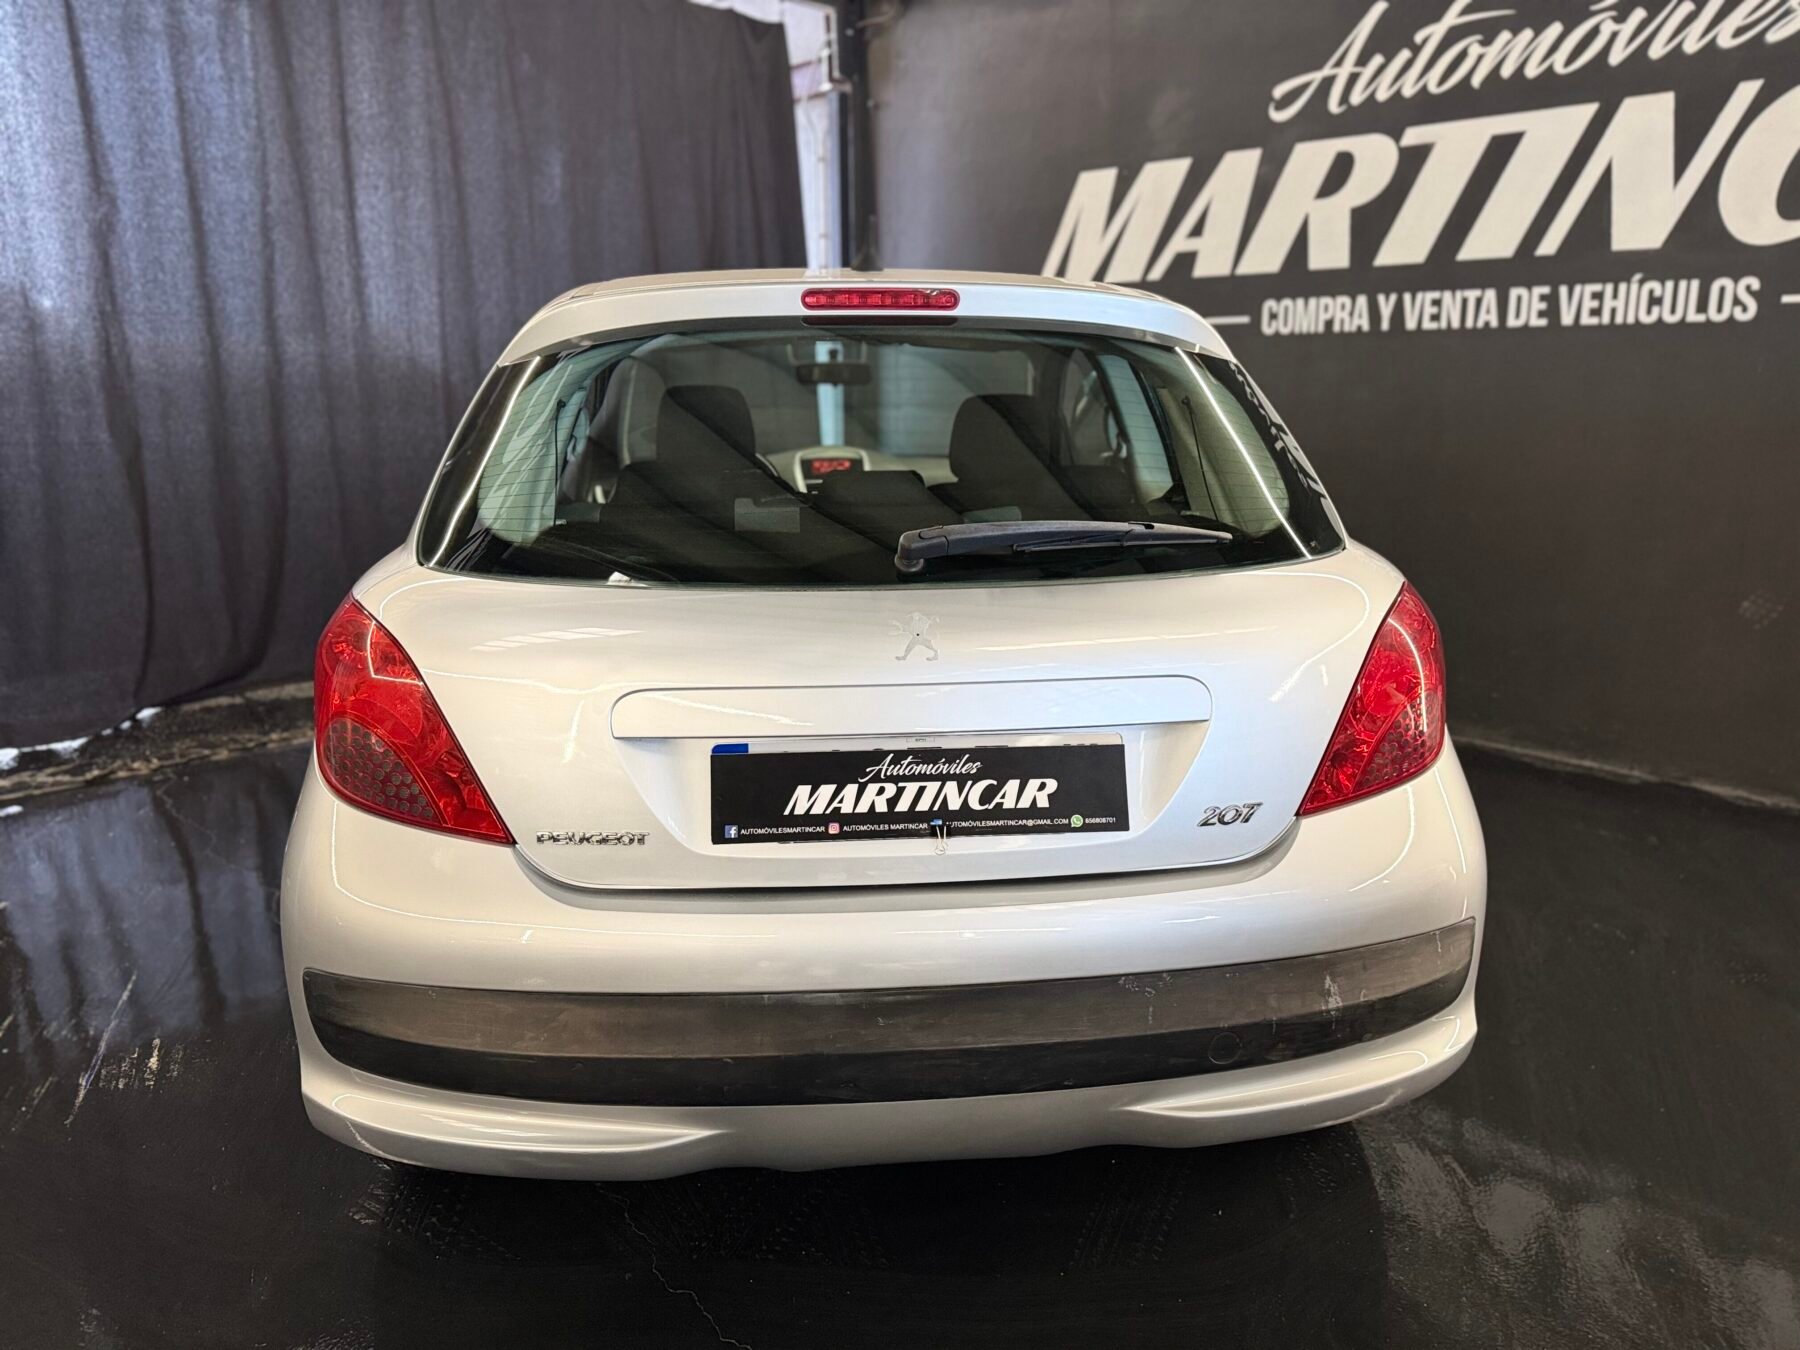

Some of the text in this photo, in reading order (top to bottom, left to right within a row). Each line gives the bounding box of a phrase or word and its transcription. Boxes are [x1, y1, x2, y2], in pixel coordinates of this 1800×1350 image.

[1260, 273, 1761, 336] COMPRA Y VENTA DE VEHÍCULOS
[858, 753, 983, 783] Automóviles
[783, 778, 1059, 816] MARTINCAR
[946, 817, 1069, 829] UTOMÓVILESMARTINCAR@GMAIL.COM
[1197, 802, 1264, 827] 207
[740, 825, 826, 836] AUTOMÓVILESMARTINCAR
[842, 822, 929, 832] AUTOMÓVILES MARTINCAR
[536, 831, 650, 846] PEUGEOT
